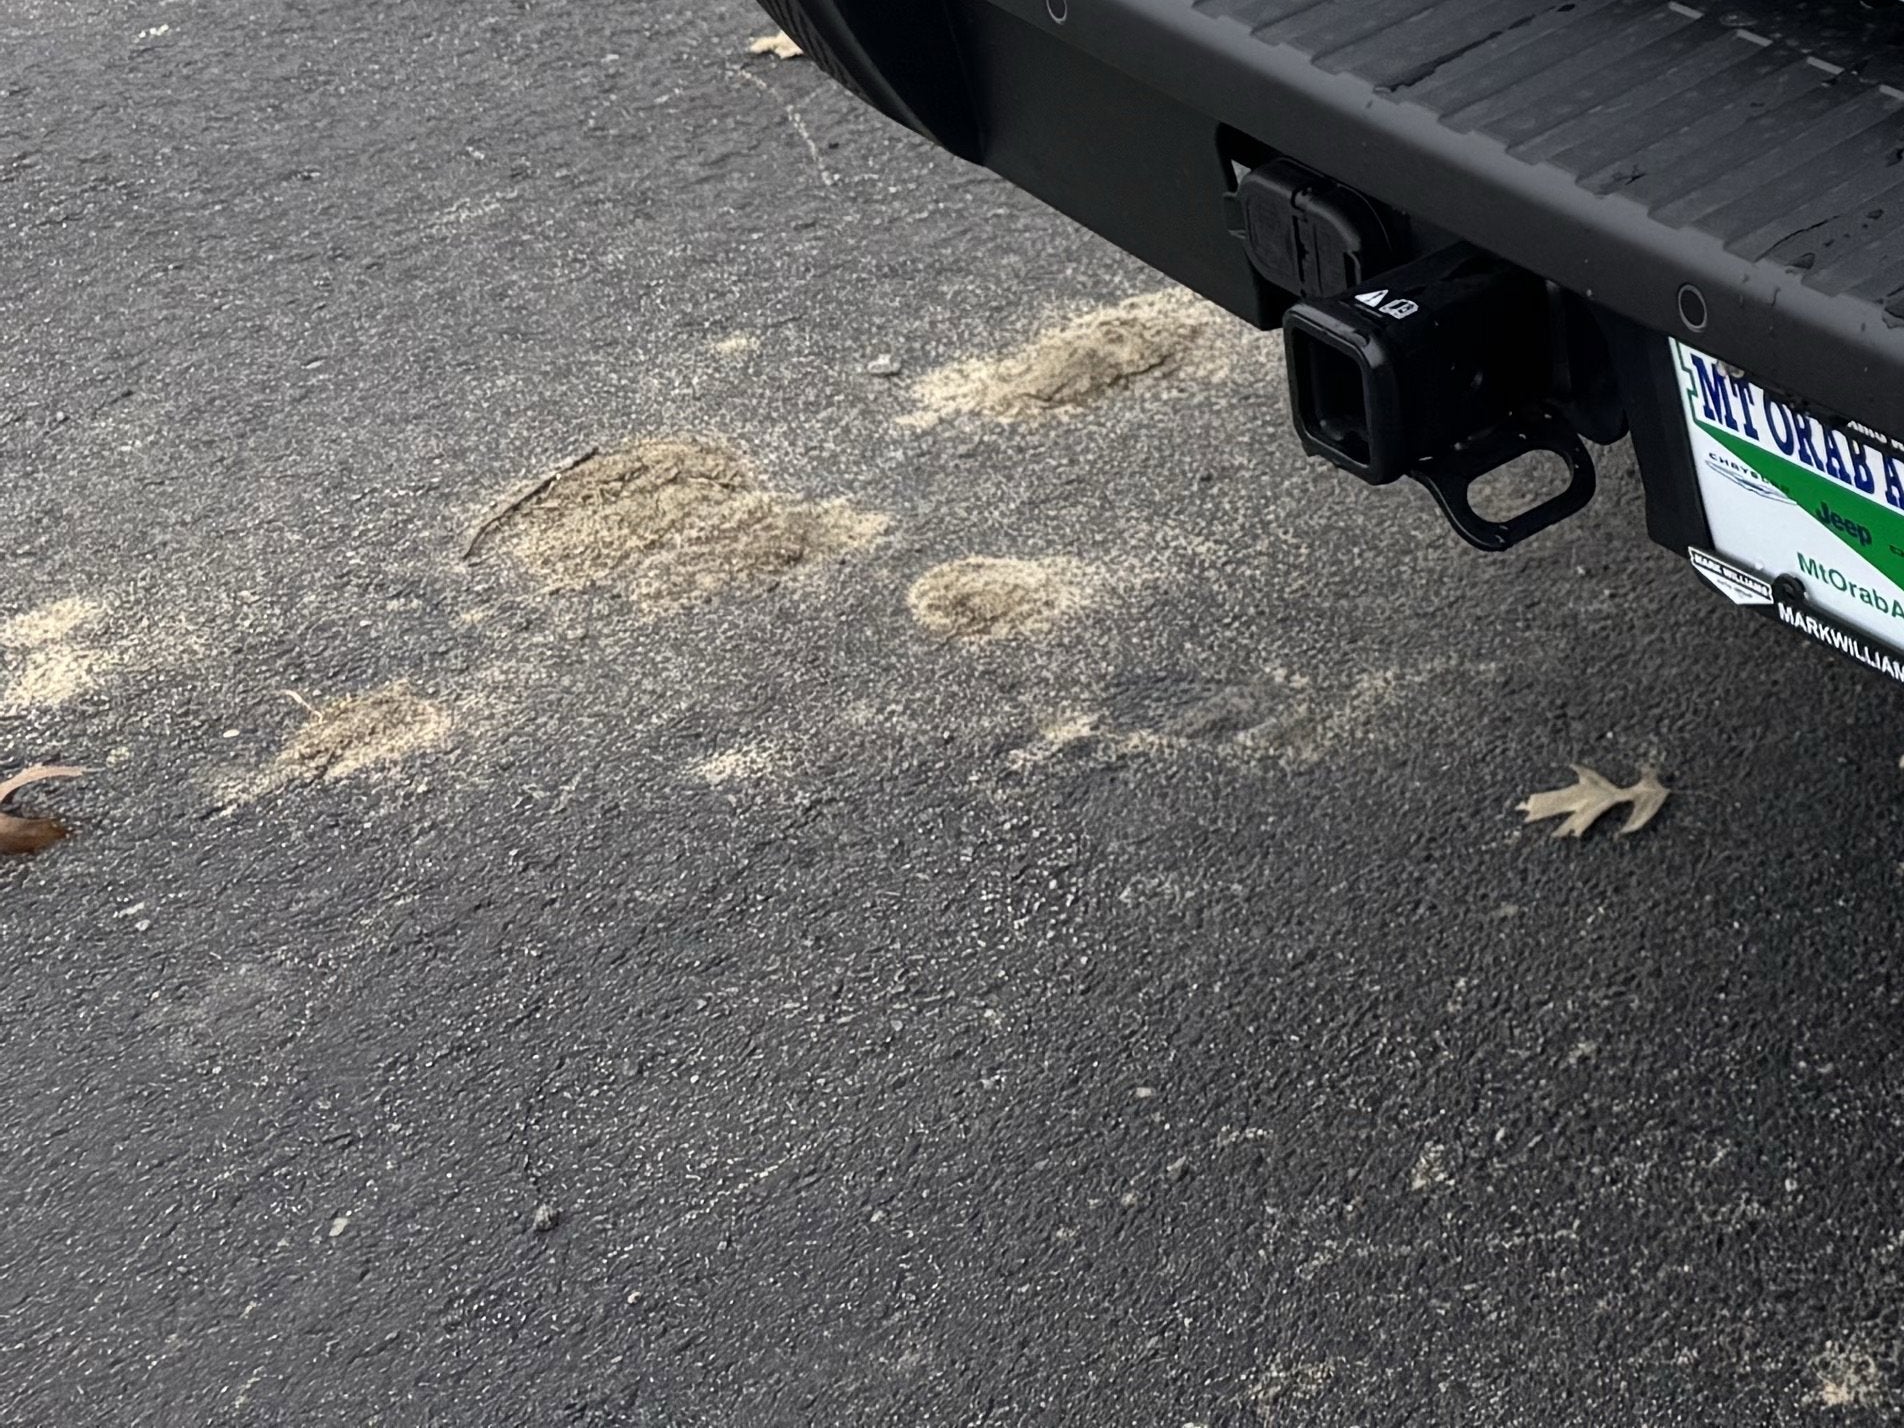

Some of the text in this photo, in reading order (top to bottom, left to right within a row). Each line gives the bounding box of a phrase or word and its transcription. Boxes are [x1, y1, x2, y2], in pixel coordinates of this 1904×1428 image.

[1690, 352, 1760, 441] MT
[1763, 388, 1876, 495] ORAB
[1815, 501, 1873, 547] Jeep
